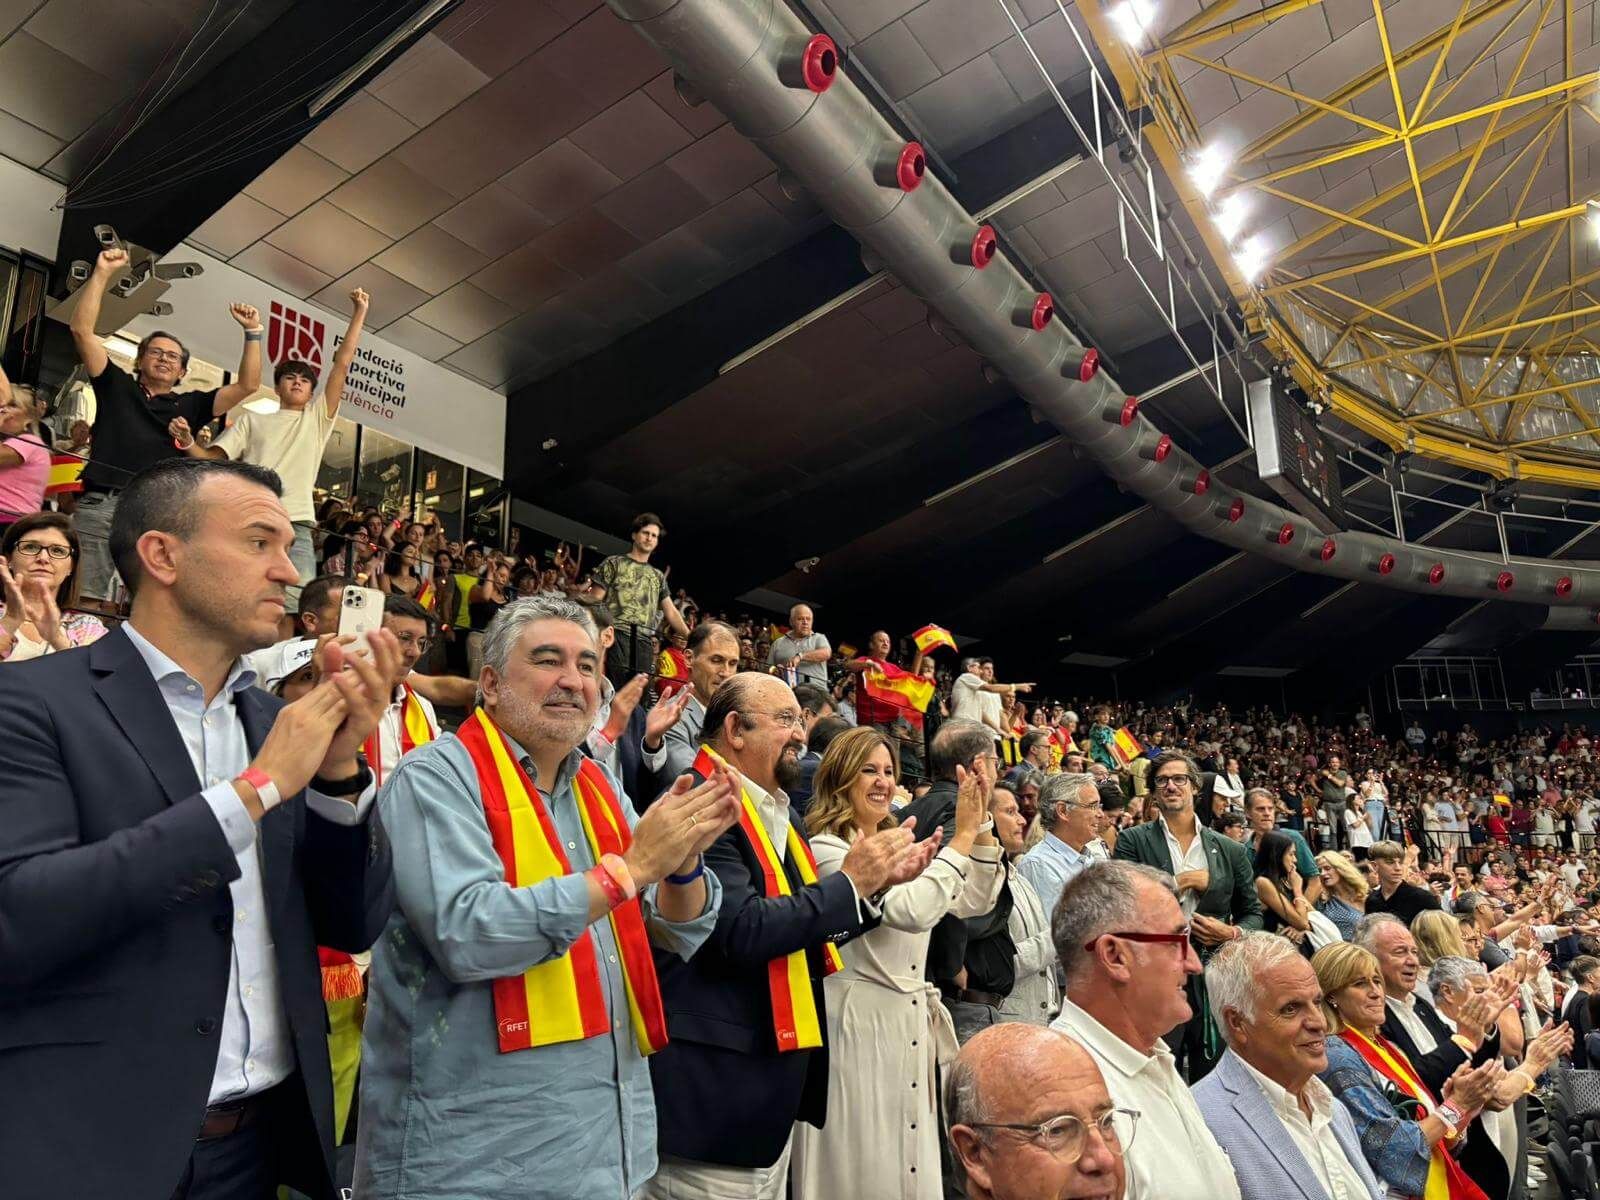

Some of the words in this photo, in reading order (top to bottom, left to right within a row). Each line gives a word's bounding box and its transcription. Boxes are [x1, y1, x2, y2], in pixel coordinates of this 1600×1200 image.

[333, 335, 403, 375] Fndació
[340, 390, 394, 419] alència
[345, 375, 406, 408] unicipal
[506, 1021, 528, 1032] RFET
